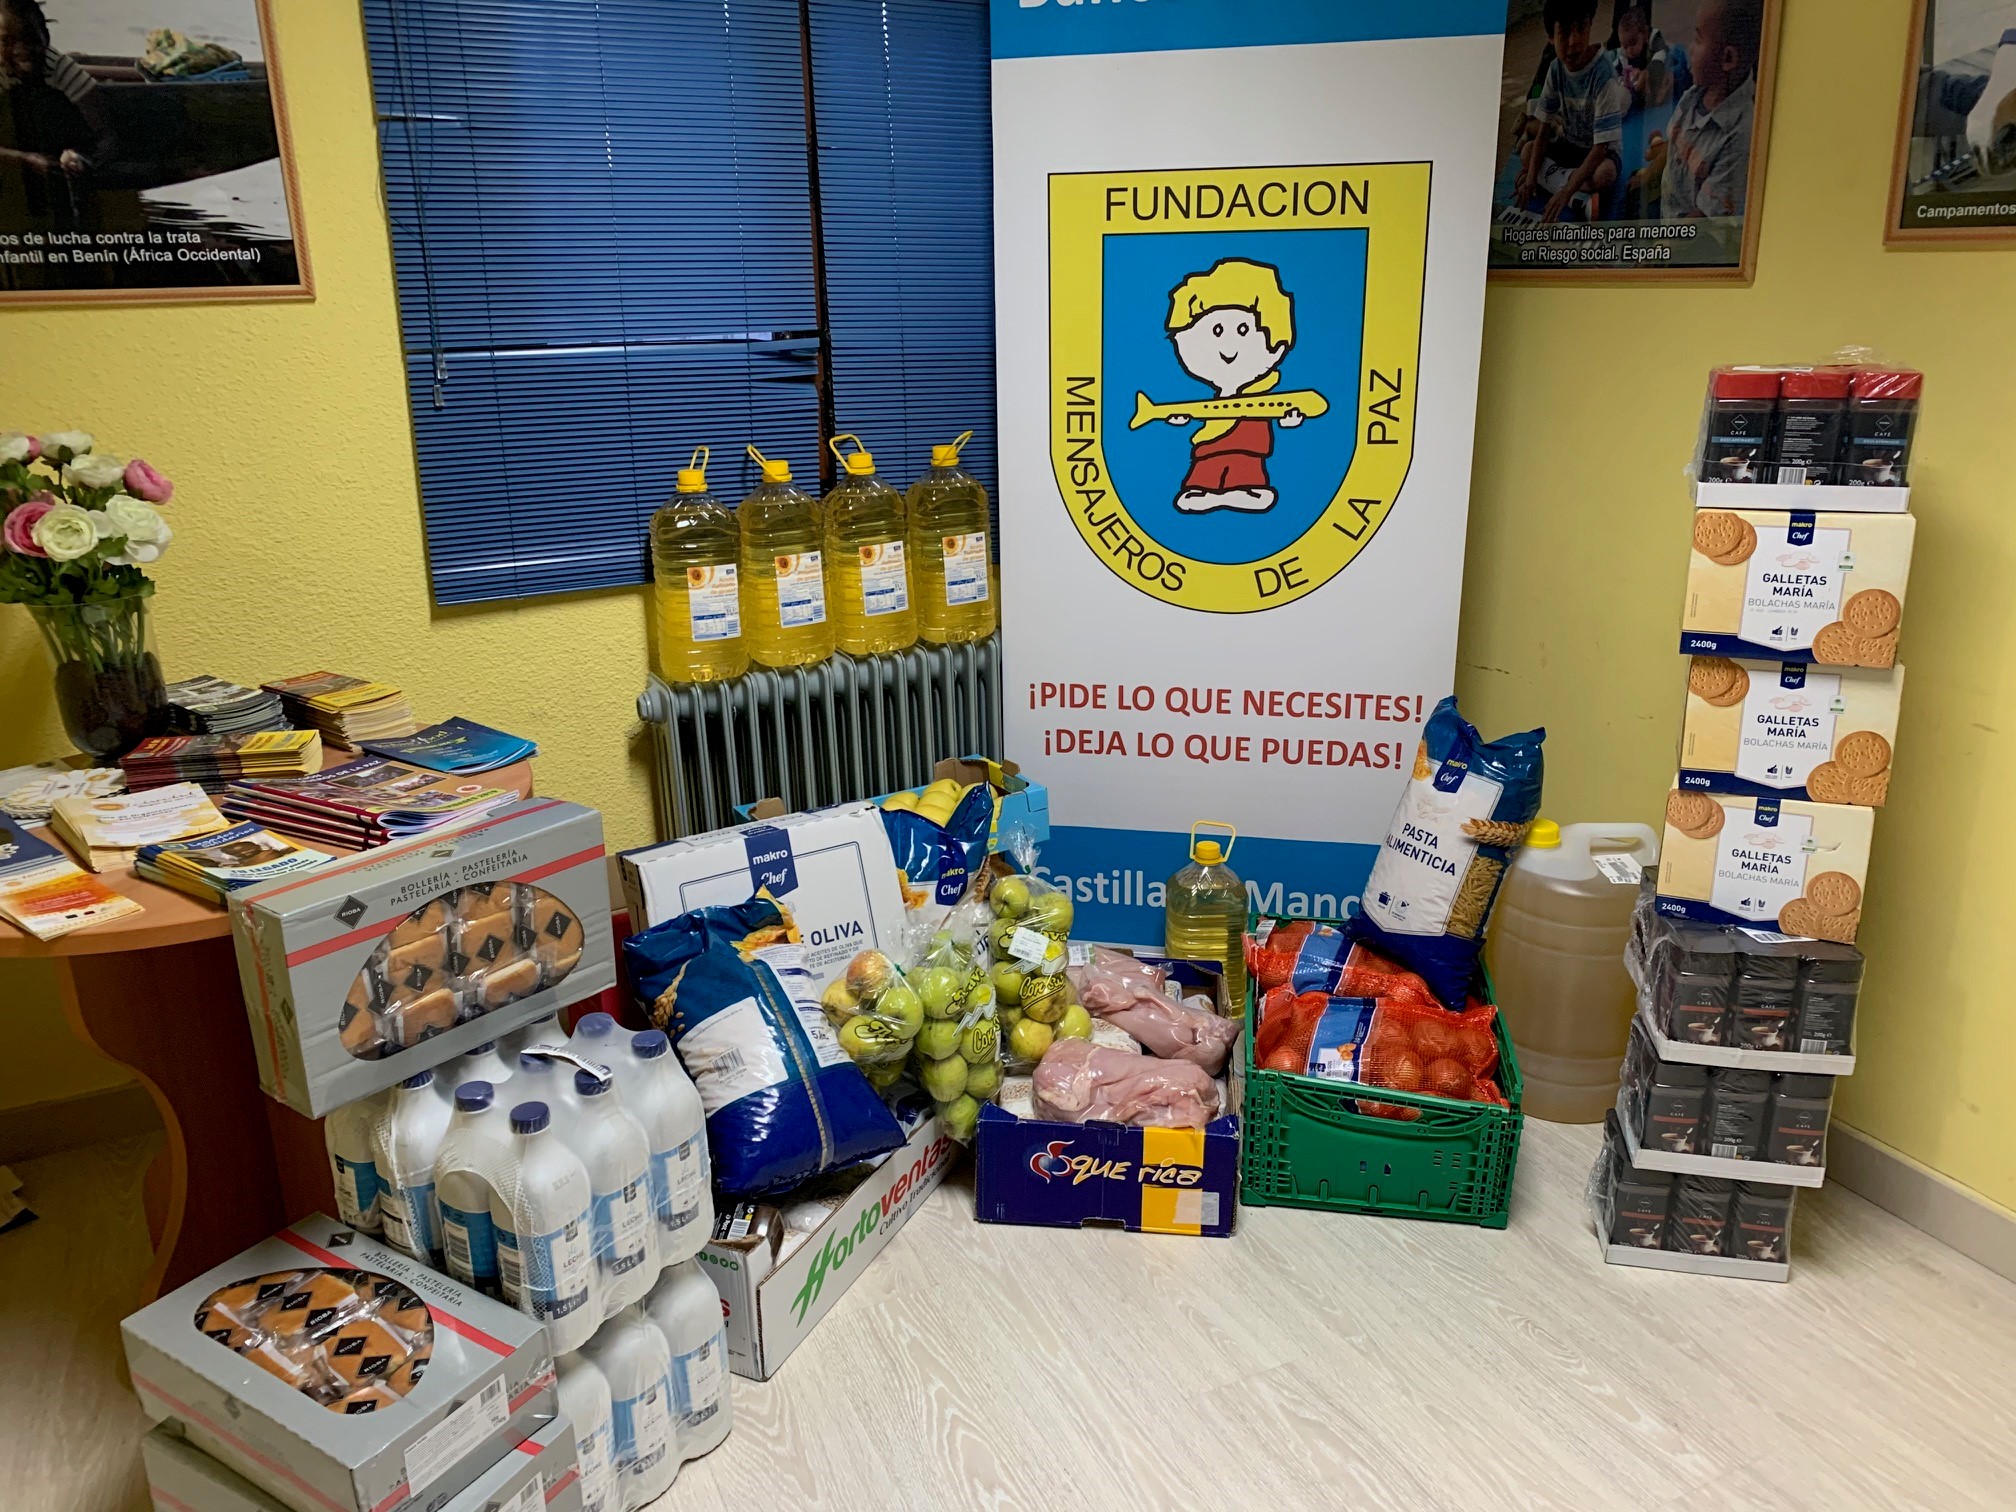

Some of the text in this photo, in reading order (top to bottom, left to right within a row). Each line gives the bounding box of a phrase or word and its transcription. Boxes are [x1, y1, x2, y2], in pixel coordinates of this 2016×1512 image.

[1105, 179, 1370, 222] FUNDACION
[1916, 203, 2016, 219] Campamentos
[23, 231, 43, 245] de
[49, 232, 91, 246] lucha
[96, 233, 144, 245] contra
[148, 231, 162, 244] la
[166, 232, 201, 244] trata
[1504, 225, 1696, 245] Hogares infantiles para menores
[50, 252, 68, 263] en
[73, 249, 119, 263] Benín
[123, 246, 174, 265] (África
[177, 247, 261, 264] Occidental)
[1521, 250, 1535, 261] en
[1538, 246, 1577, 264] Riesgo
[1622, 245, 1670, 262] España
[1065, 367, 1402, 600] MENSAJEROS DE LA PAZ
[1792, 531, 1810, 541] Chef
[1762, 573, 1827, 586] GALLETAS
[1772, 585, 1813, 598] MARÍA
[1748, 597, 1836, 611] BOLACHAS MARÍA
[1691, 639, 1717, 651] 2400g
[1785, 676, 1802, 685] Chef
[1029, 682, 1424, 724] ¡PIDE LO QUE NECESITES!
[1757, 714, 1820, 727] GALLETAS
[1767, 726, 1807, 739] MARÍA
[1044, 728, 1403, 770] ¡DEJA LO QUE PUEDAS!
[1743, 737, 1828, 751] BOLACHAS MARÍA
[363, 759, 382, 769] PAZ
[1685, 776, 1711, 787] 2400g
[1758, 814, 1775, 823] Chef
[1401, 822, 1439, 850] PASTA
[752, 849, 788, 866] makro
[1385, 833, 1457, 877] ALIMENTICIA
[1731, 848, 1792, 865] GALLETAS
[249, 857, 298, 873] LEGADO
[401, 872, 451, 895] BOLLERÍA
[462, 849, 518, 874] PASTELERÍA
[1741, 860, 1779, 875] MARÍA
[390, 854, 528, 906] PASTELARIA CONFEITARIA
[761, 868, 788, 886] Chef
[1718, 869, 1800, 889] BOLACHAS MARÍA
[940, 884, 963, 896] Chef
[1030, 866, 1166, 907] Castilla
[341, 907, 362, 919] RIOBA
[1661, 902, 1686, 914] 2400g
[810, 920, 864, 947] OLIVA
[811, 948, 832, 958] ACEITES
[838, 943, 853, 952] OLIVA
[824, 950, 846, 960] REFINADO
[676, 1169, 697, 1186] LECHE
[621, 1213, 643, 1229] LECHE
[879, 1200, 908, 1236] Cultivo
[790, 1134, 956, 1329] Hortoventas
[562, 1249, 586, 1270] LECHE
[360, 1252, 463, 1308] PASTELARIA CONFEITARIA
[375, 1251, 462, 1298] BOLLERÍA PASTELERÍA
[285, 1294, 308, 1309] RIOBA
[310, 1311, 332, 1325] RIOBA
[556, 1303, 569, 1317] 1,5
[338, 1338, 362, 1354] RIOBA
[363, 1357, 386, 1373] RIOBA
